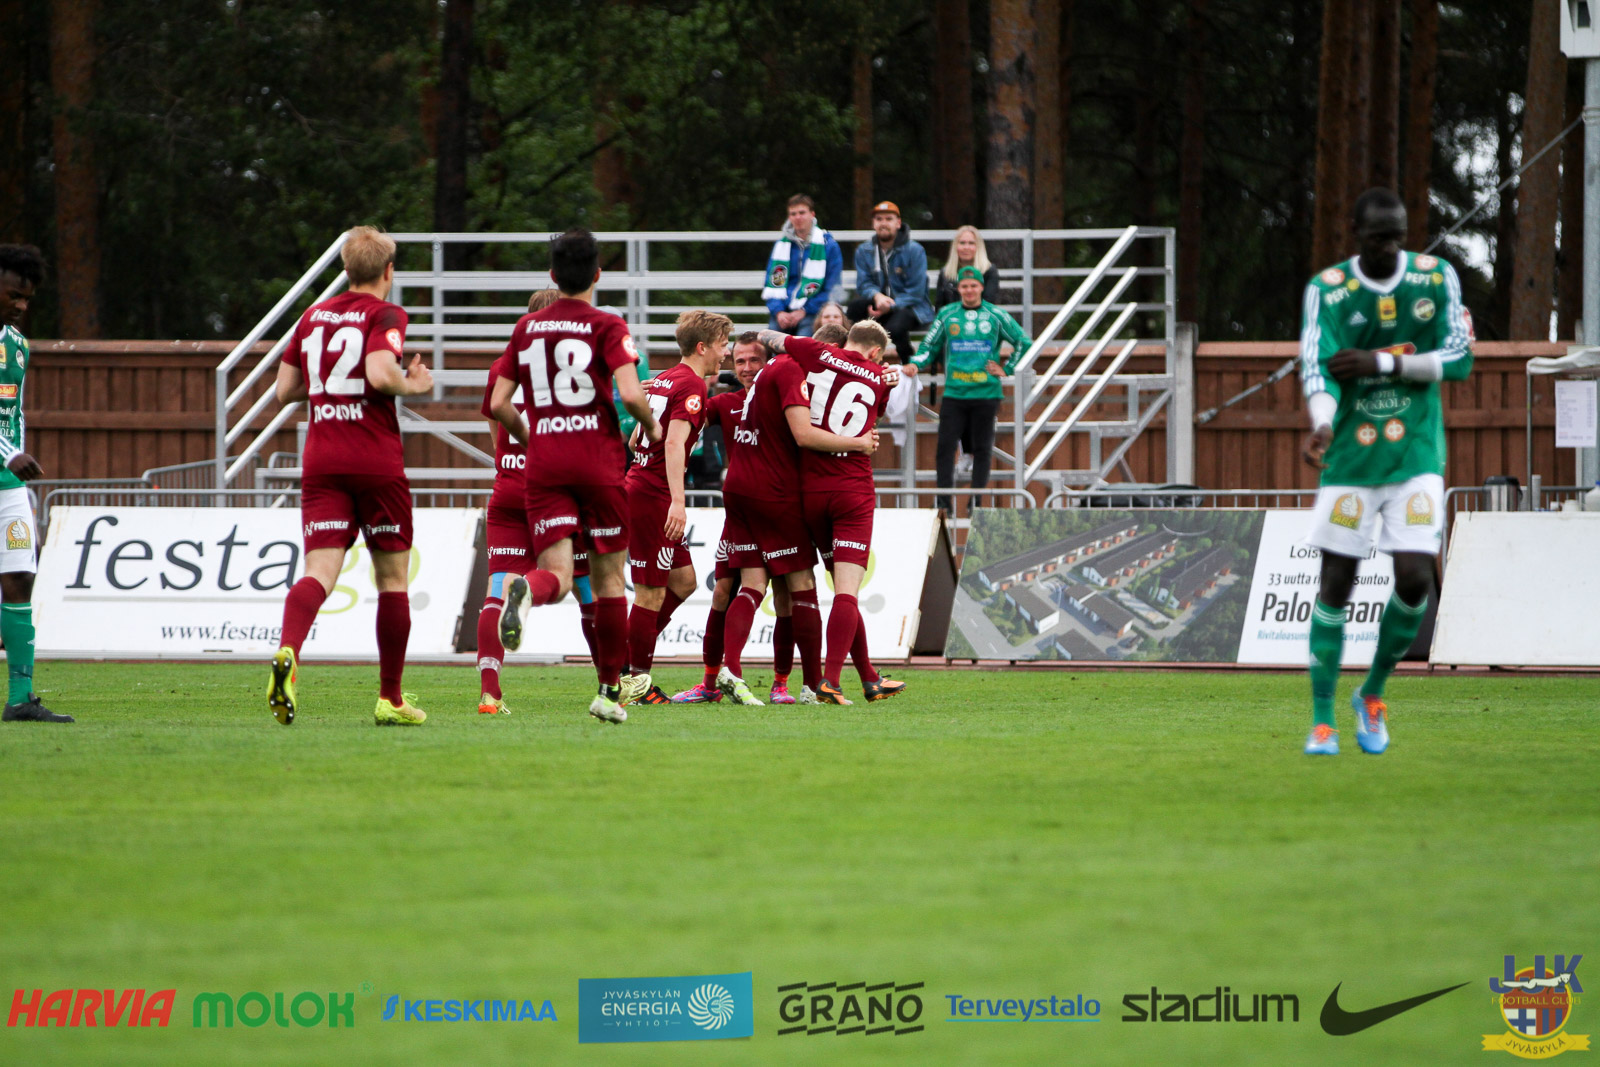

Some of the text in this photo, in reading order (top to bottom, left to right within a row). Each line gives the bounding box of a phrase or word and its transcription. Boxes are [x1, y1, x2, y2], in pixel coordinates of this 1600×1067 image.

[533, 321, 592, 333] KESKIMAA
[301, 326, 365, 395] 12
[518, 338, 596, 407] 18
[828, 355, 882, 385] KESKIMAA
[806, 368, 876, 438] 16
[536, 414, 599, 435] MOLOK
[313, 520, 349, 531] FIRSTBEAT
[545, 516, 578, 529] FIRSTBEAT
[492, 547, 526, 557] FIRSTBEAT
[837, 540, 867, 552] FIRSTBEAT
[767, 546, 799, 560] FIRSTBEAT
[1268, 573, 1282, 586] 33
[1284, 573, 1312, 585] uutta
